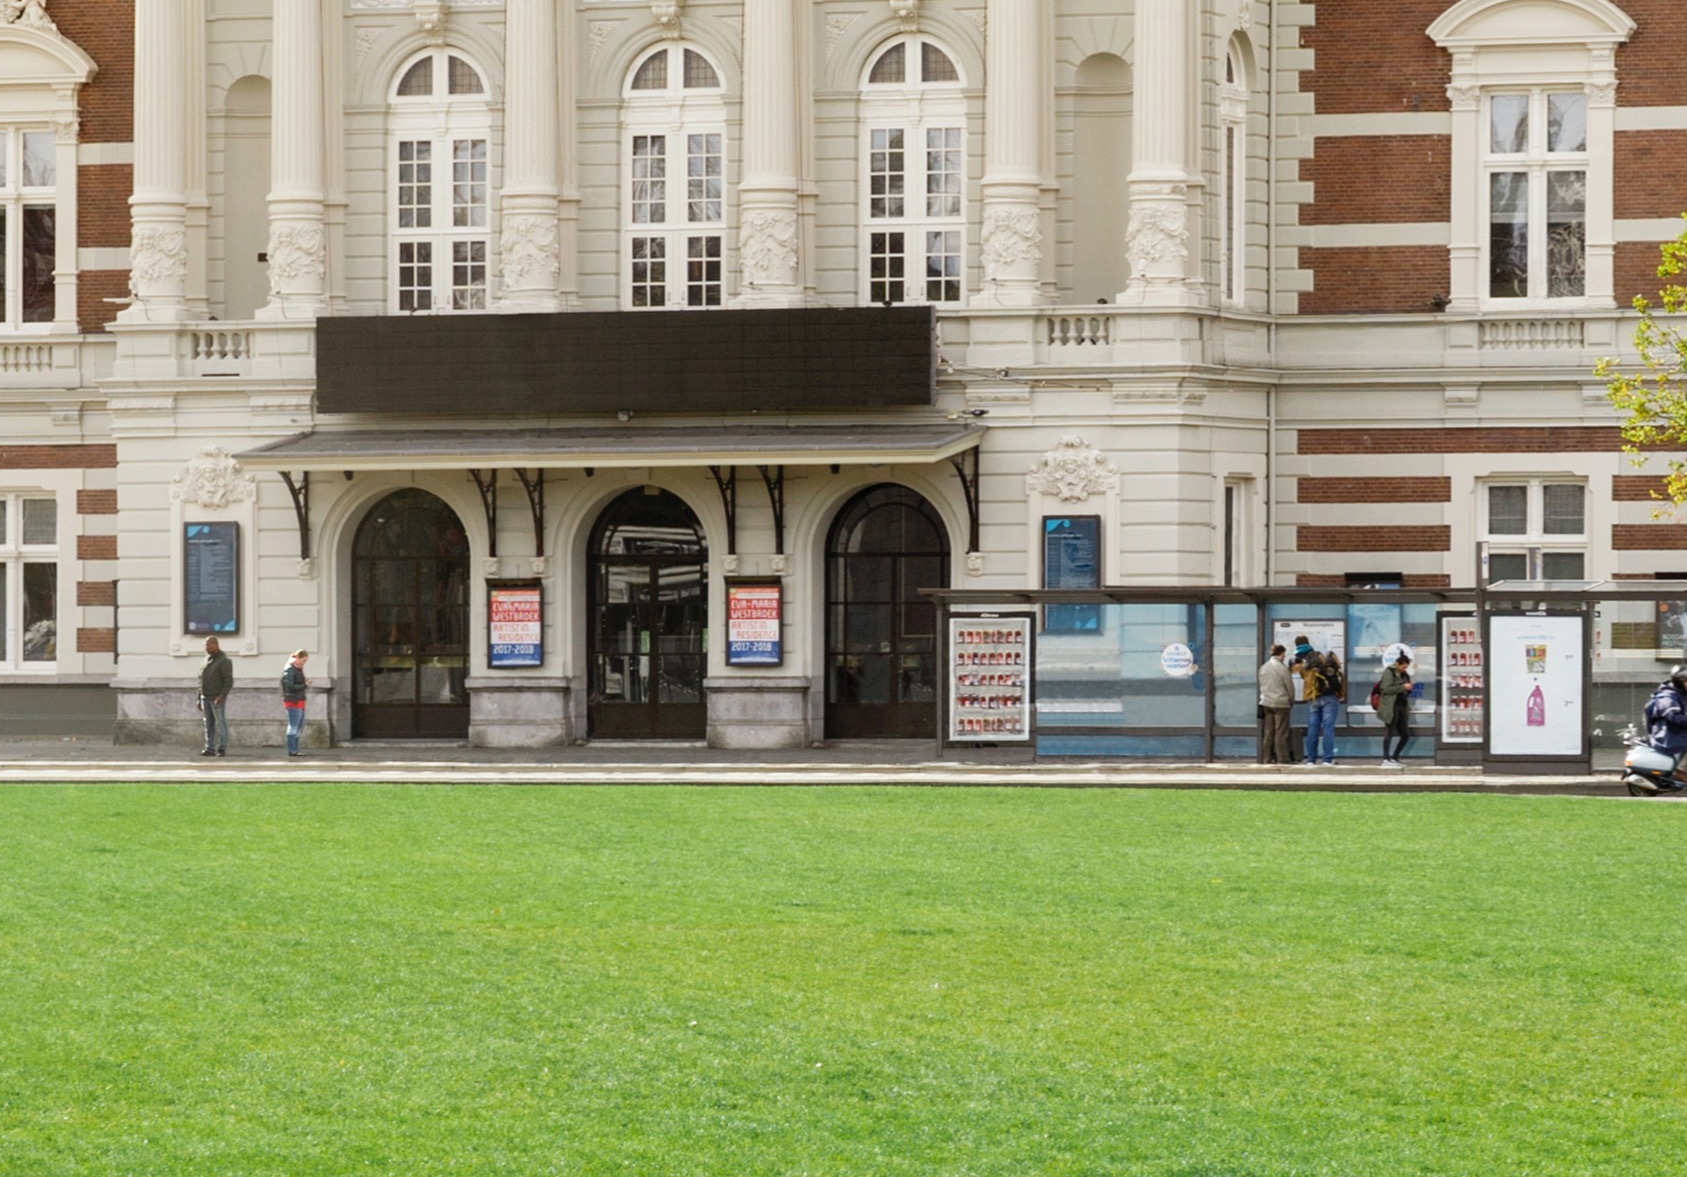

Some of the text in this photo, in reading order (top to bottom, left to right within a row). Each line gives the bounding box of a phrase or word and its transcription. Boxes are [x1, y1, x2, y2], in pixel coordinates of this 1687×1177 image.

[492, 602, 539, 611] EVA-MARIA
[731, 599, 778, 609] EVA-MARIA
[492, 612, 540, 621] WESTBROEK
[731, 609, 778, 618] WESTBROEK
[493, 624, 520, 632] ARTIST
[732, 621, 758, 629] ARTIST
[498, 633, 539, 641] RESIDENCE
[737, 631, 777, 639] RESIDENCE
[493, 645, 534, 654] 2017-2018
[731, 642, 772, 651] 2017-2018
